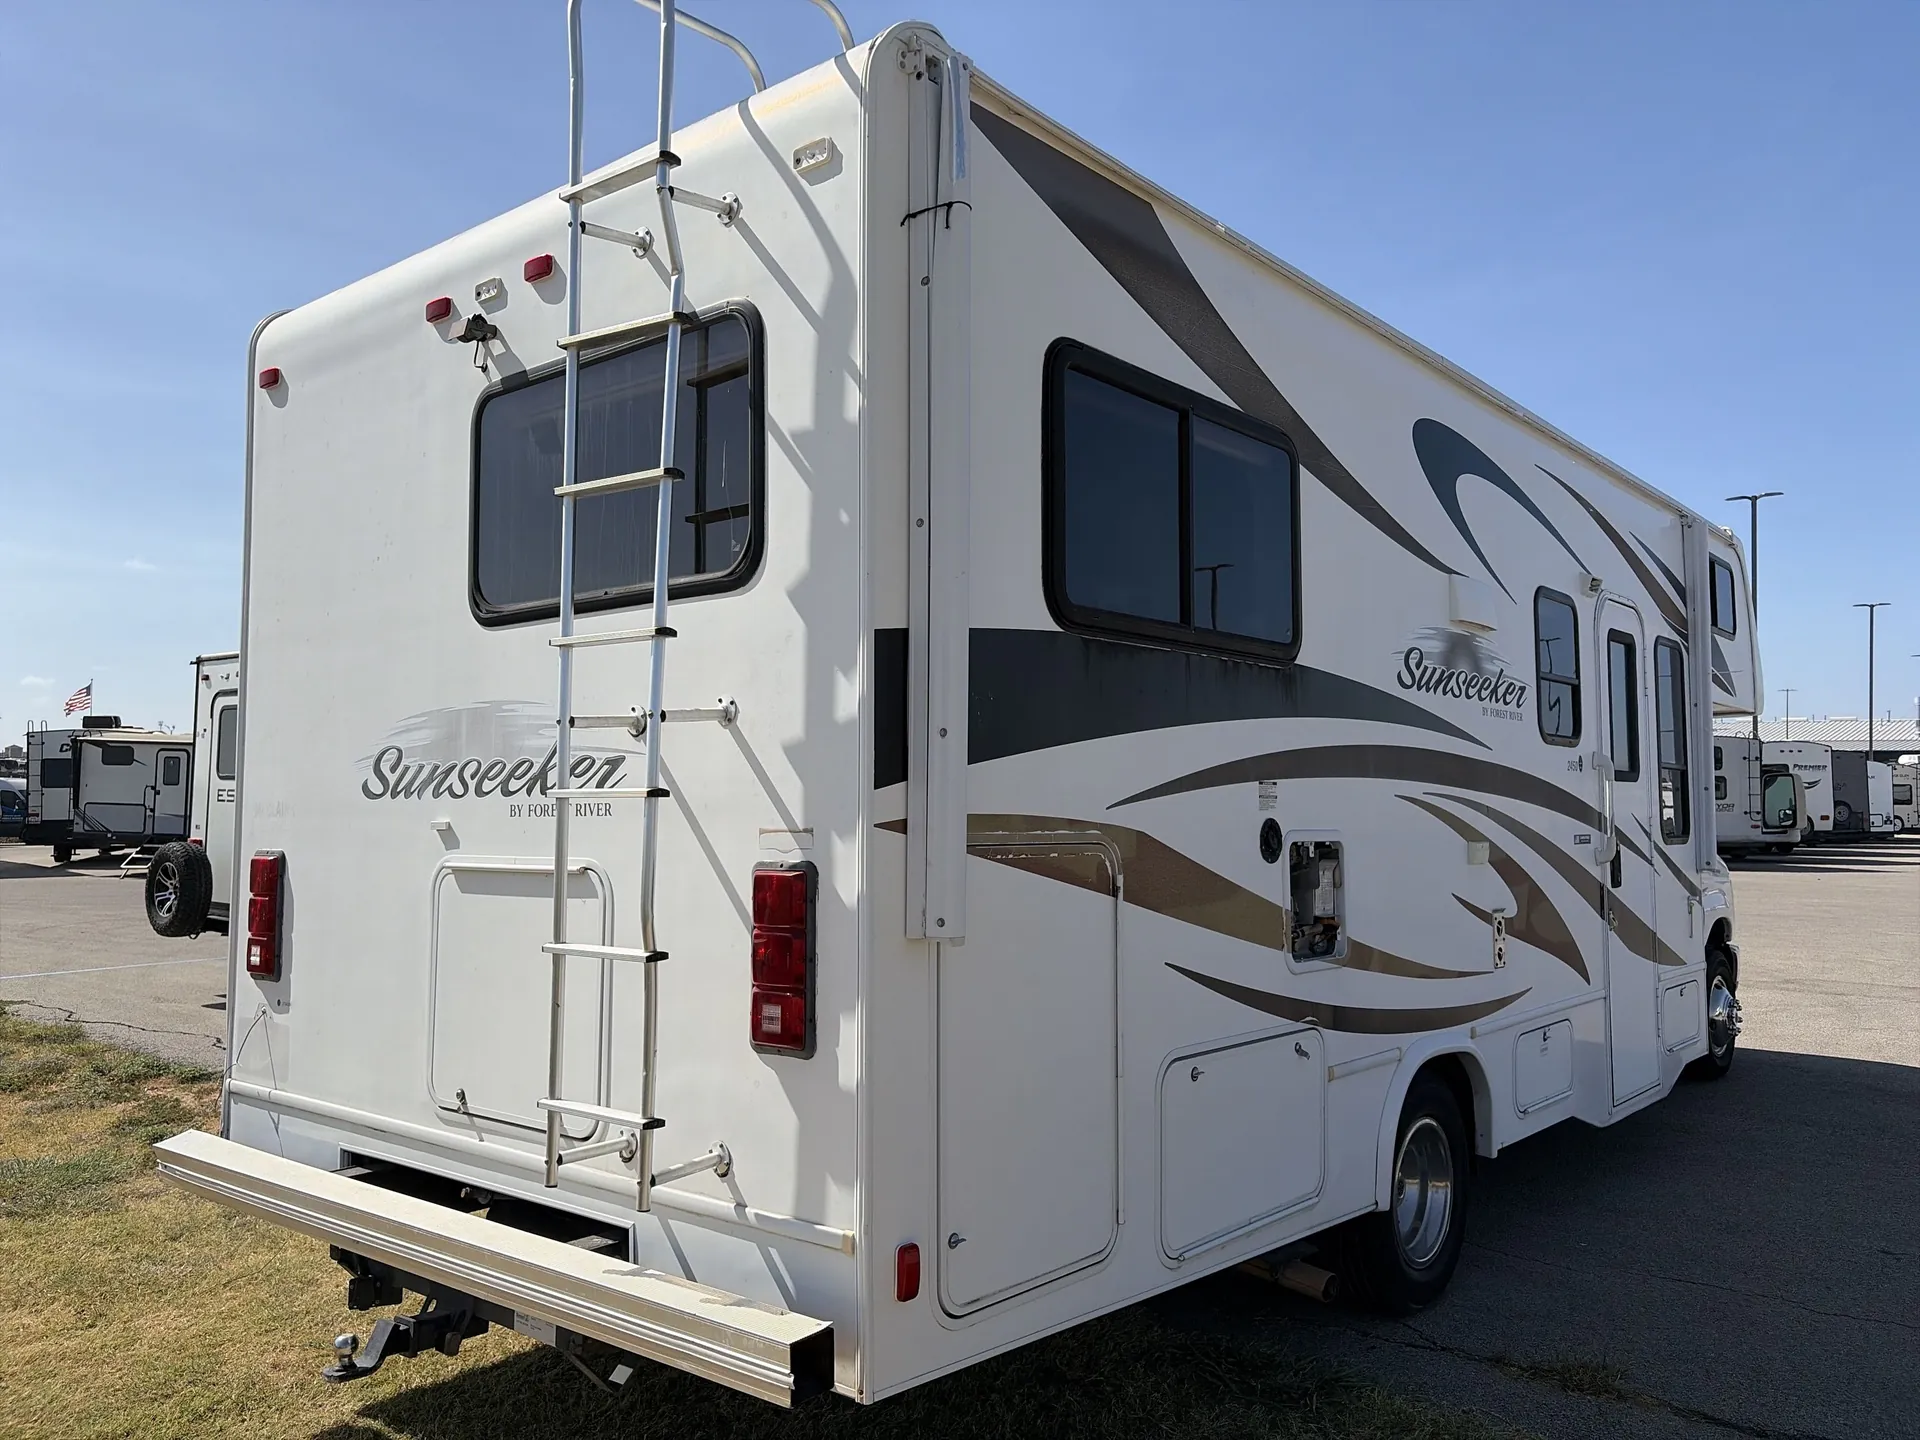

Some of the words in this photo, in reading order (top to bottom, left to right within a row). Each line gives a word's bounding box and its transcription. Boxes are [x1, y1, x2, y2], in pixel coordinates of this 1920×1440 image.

[1396, 646, 1528, 709] Sunseeker
[1482, 706, 1489, 717] BY
[1490, 707, 1508, 719] FOREST
[1509, 710, 1523, 721] RIVER
[361, 739, 628, 800] Sunseeker
[1792, 763, 1828, 771] PREMIER
[509, 804, 524, 818] BY
[528, 803, 573, 818] FORE
[575, 802, 613, 817] RIVER
